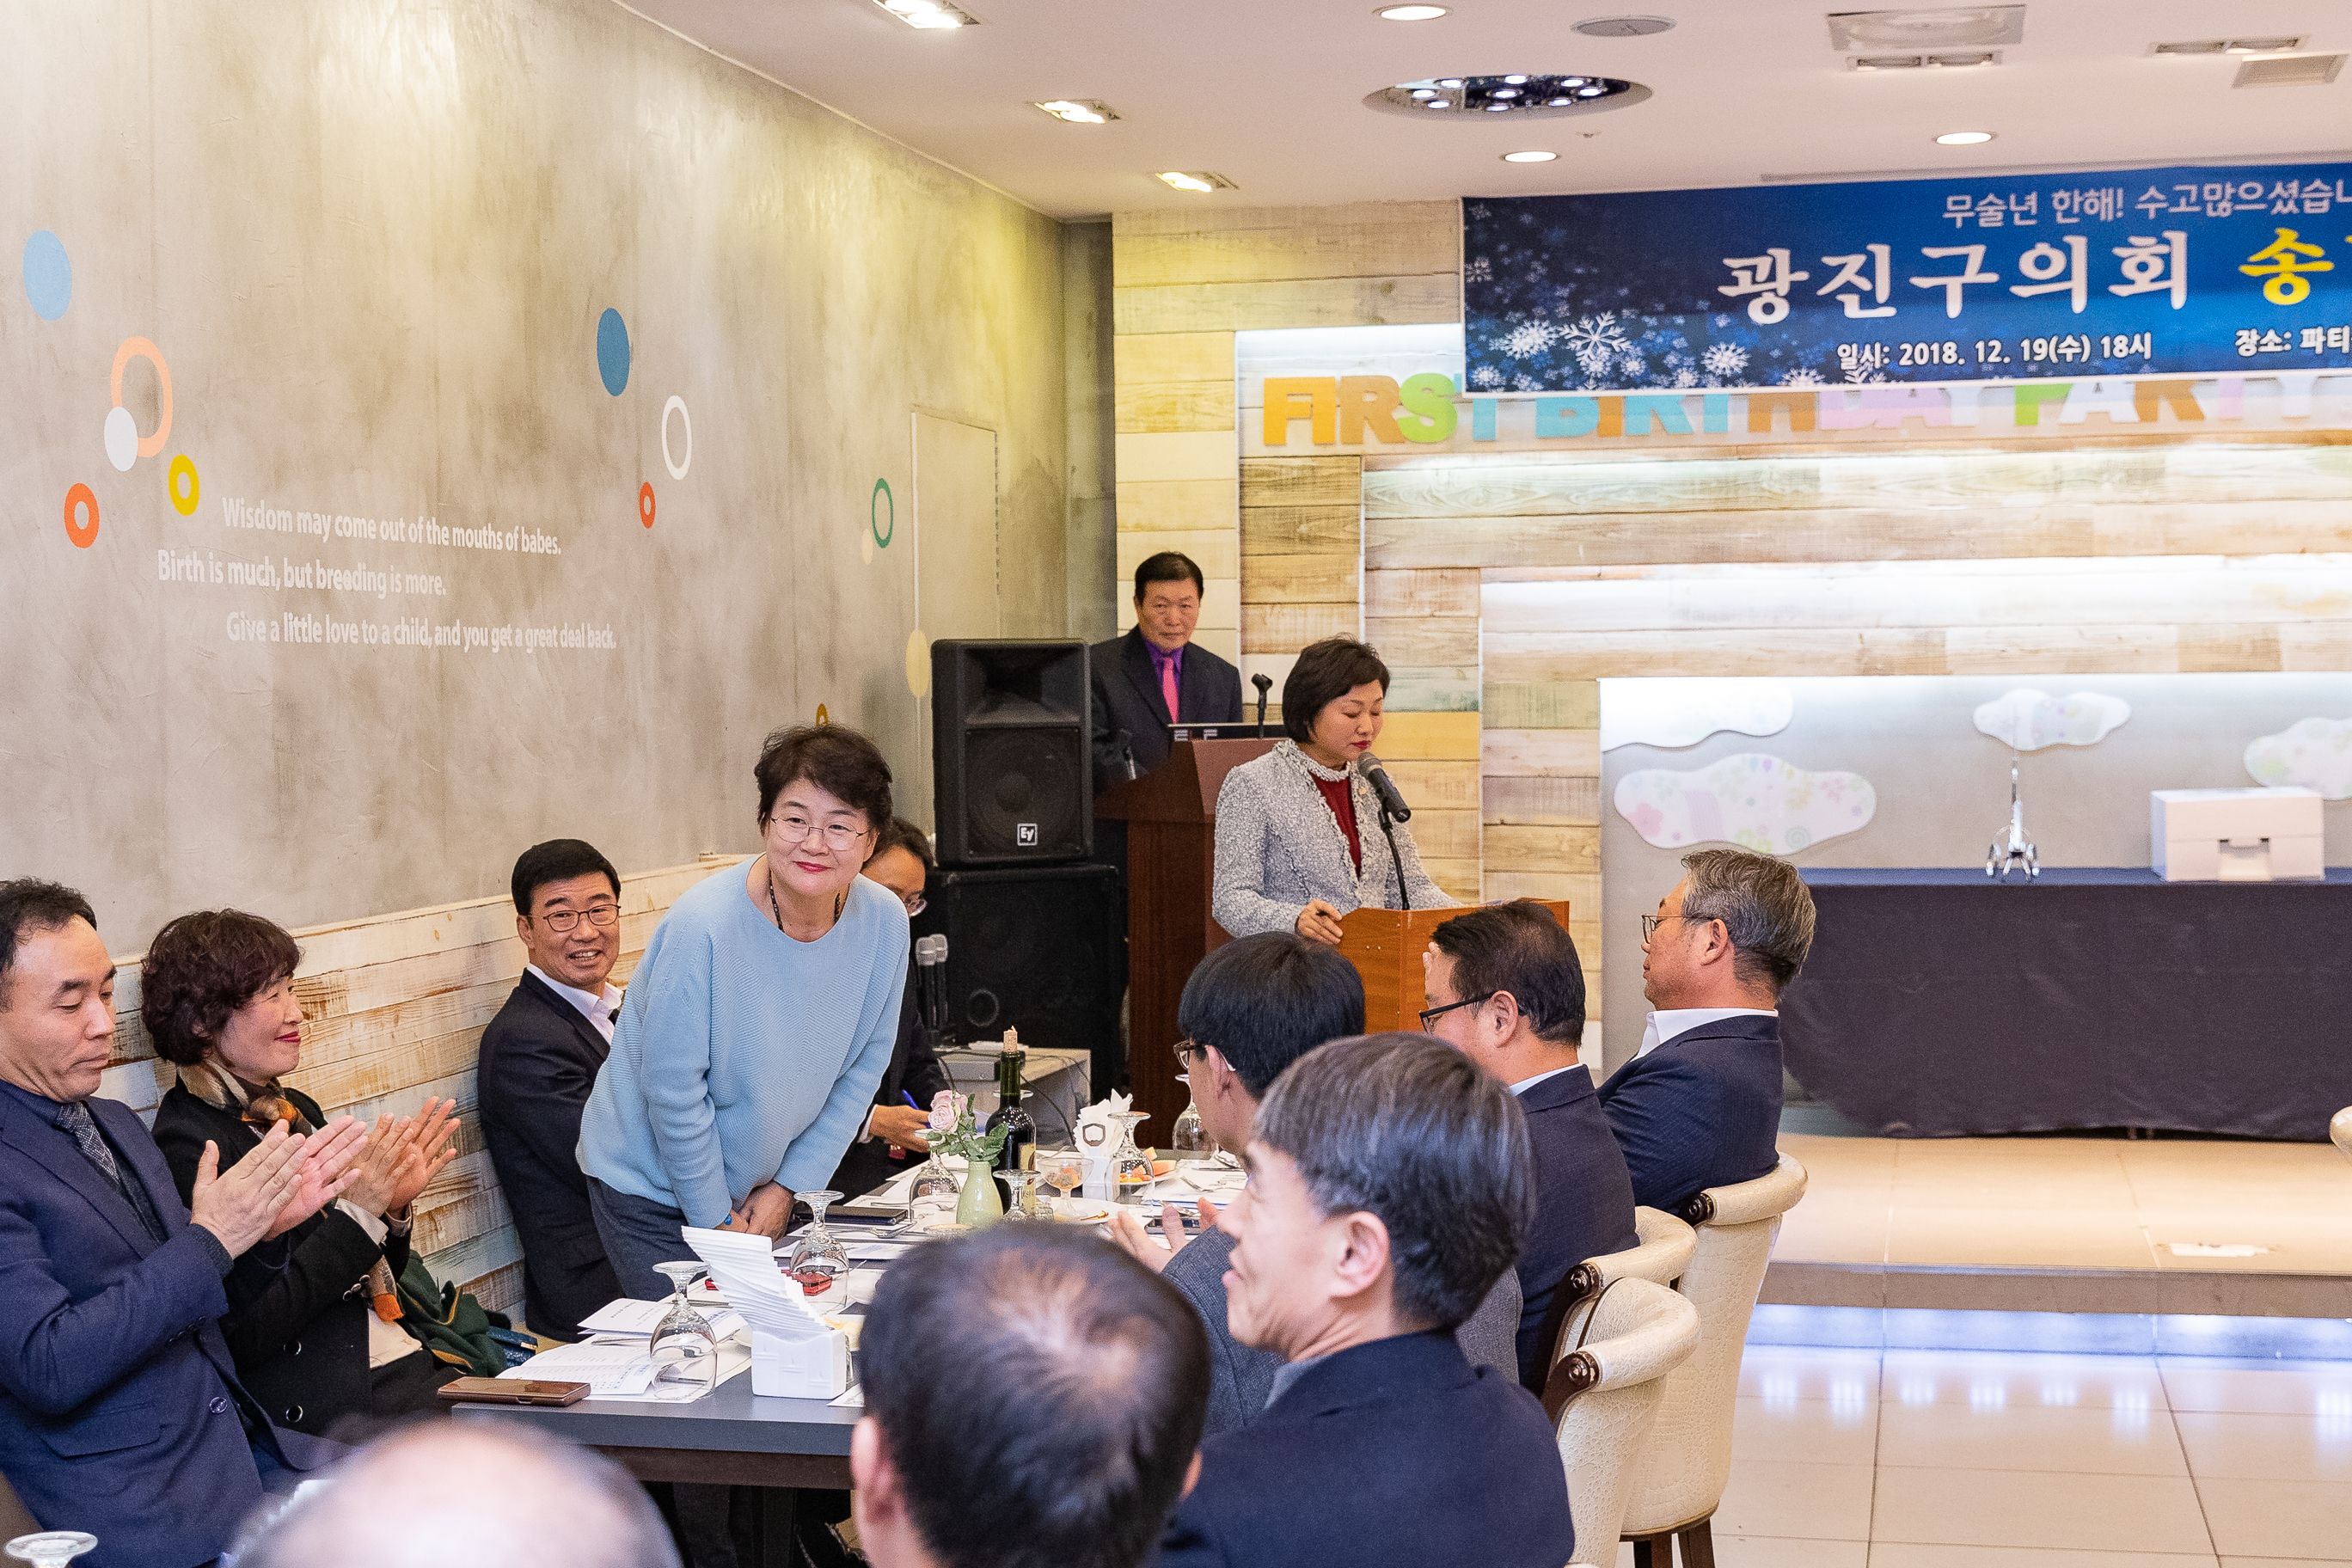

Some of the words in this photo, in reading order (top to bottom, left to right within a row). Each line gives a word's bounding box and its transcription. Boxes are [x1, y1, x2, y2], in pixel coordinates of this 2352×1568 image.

[1942, 191, 2038, 230] 무술년
[2051, 187, 2123, 224] 한해!
[1718, 230, 2189, 324] 광진구의회
[2238, 227, 2352, 305] 송
[1837, 342, 1890, 371] 일시:
[1898, 341, 1966, 366] 2018.
[1975, 339, 2012, 364] 12.
[2020, 334, 2092, 364] 19(수)
[2100, 332, 2152, 360] 18시
[2235, 328, 2293, 357] 장소:
[2300, 325, 2352, 354] 파티
[222, 496, 293, 533] Wisdom
[297, 511, 332, 543] may
[334, 516, 377, 540] come
[379, 518, 406, 542] out
[407, 516, 424, 543] of
[426, 517, 450, 546] the
[452, 524, 503, 550] mouths
[505, 525, 519, 551] of
[521, 526, 562, 555] babes.
[157, 549, 205, 583] Birth
[208, 551, 224, 585] is
[227, 555, 281, 591] much,
[283, 556, 313, 589] but
[315, 559, 387, 599] breeding
[389, 564, 402, 593] is
[406, 573, 447, 597] more.
[226, 610, 266, 642] Give
[270, 620, 280, 643] a
[283, 611, 323, 644] little
[325, 613, 359, 645] love
[362, 619, 378, 645] to
[381, 623, 390, 646] a
[434, 618, 461, 646] and
[462, 626, 489, 653] you
[490, 623, 512, 654] get
[514, 627, 524, 647] a
[525, 625, 558, 654] great
[560, 622, 585, 648] deal
[586, 622, 617, 650] back.
